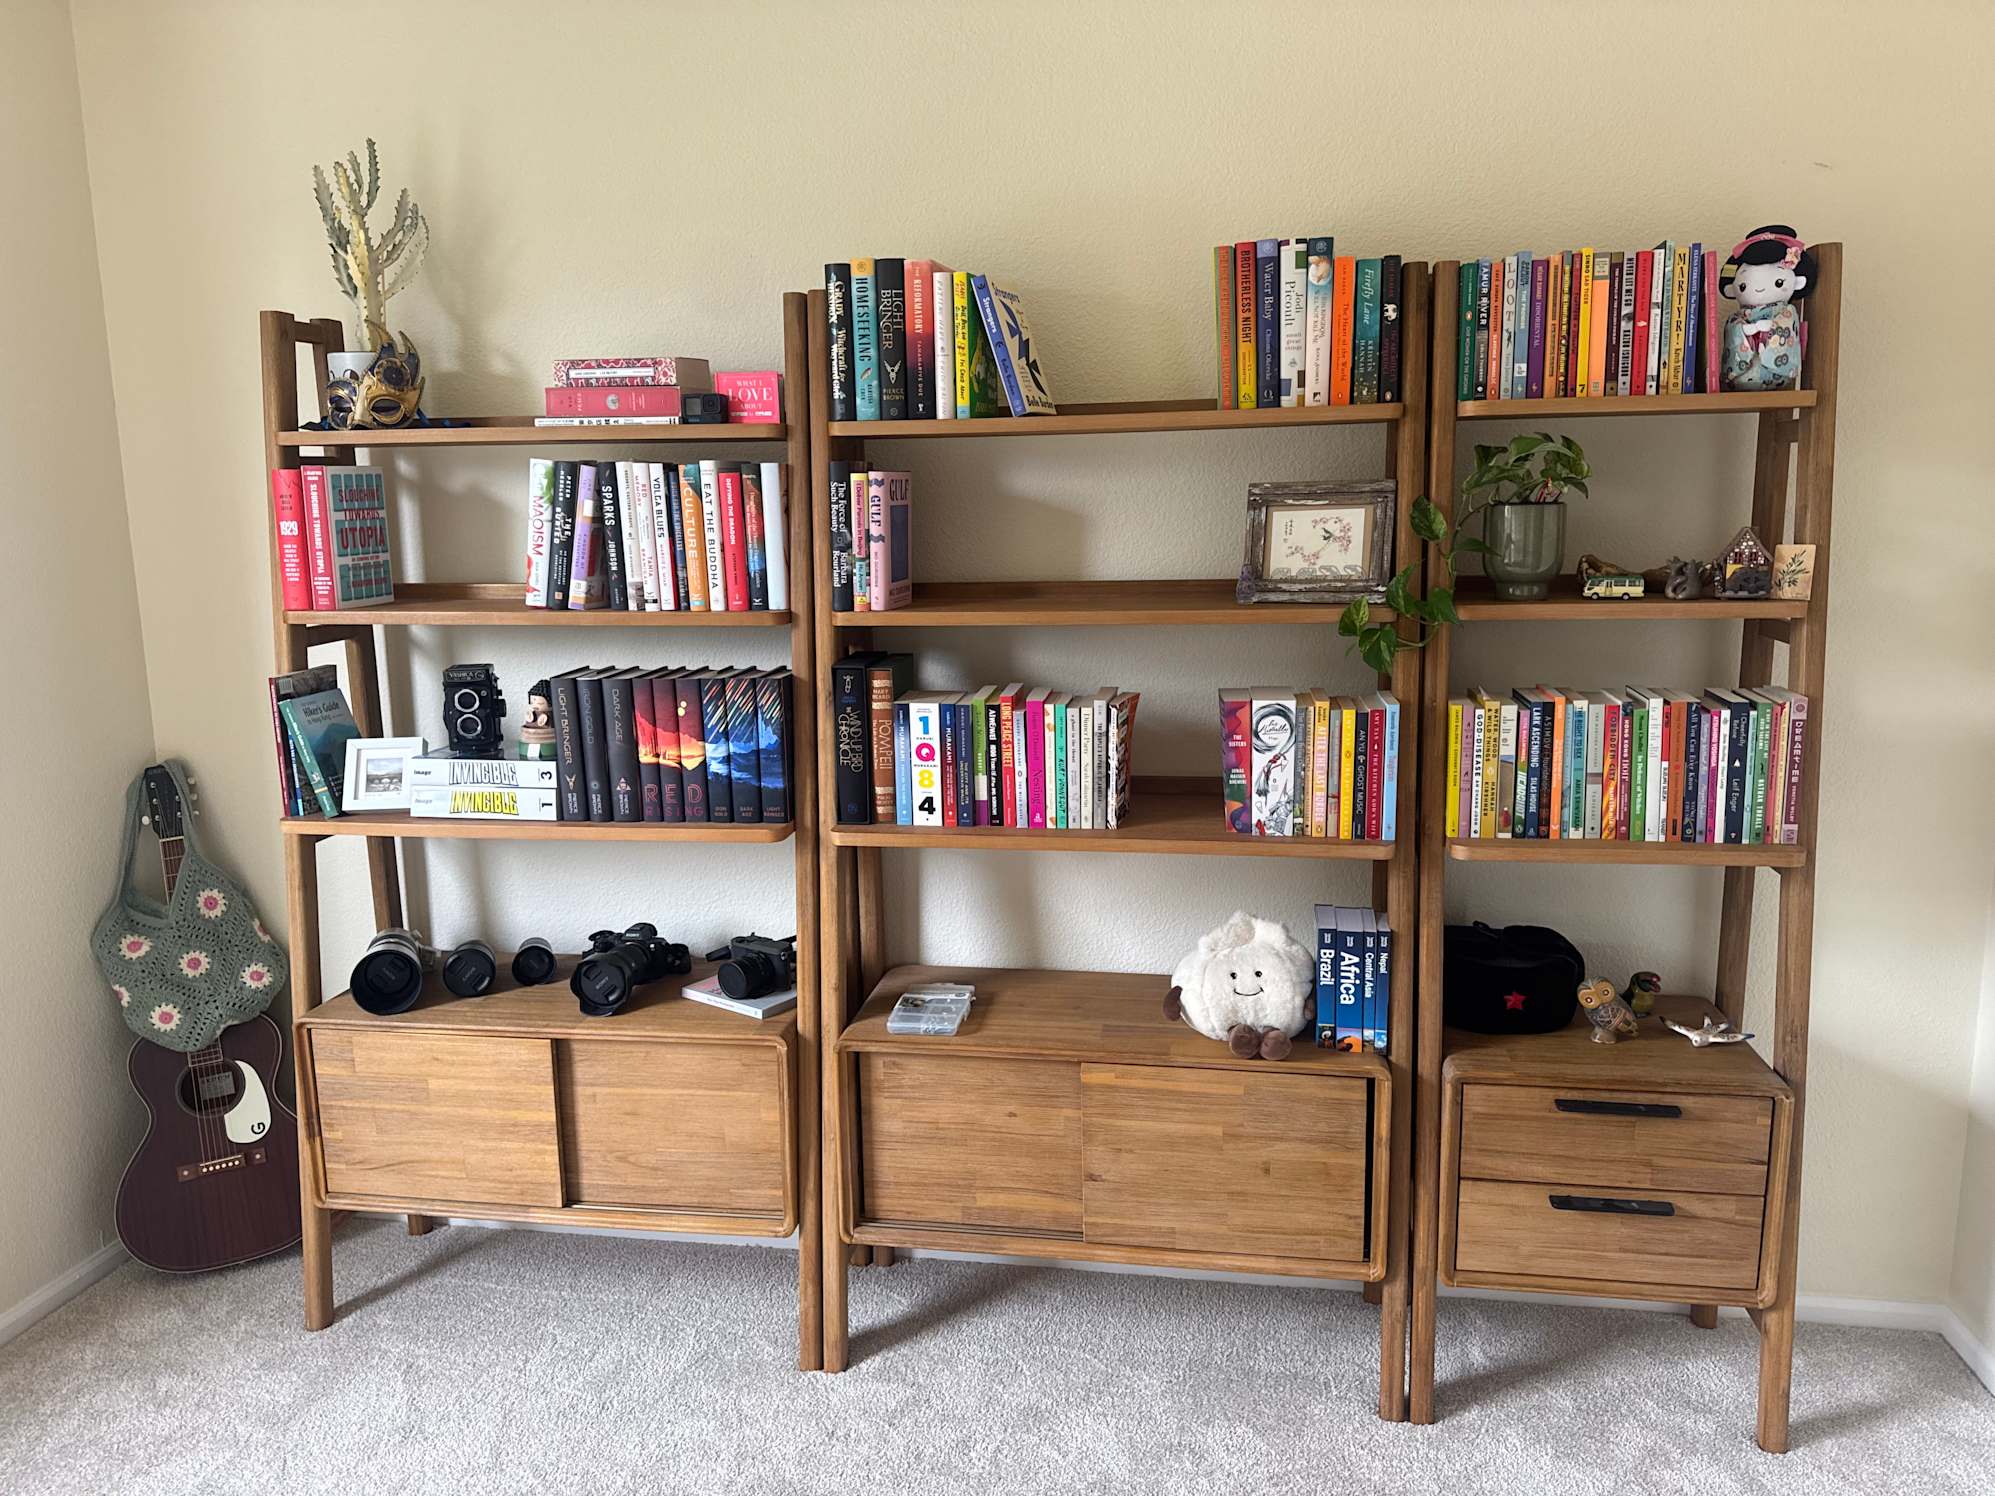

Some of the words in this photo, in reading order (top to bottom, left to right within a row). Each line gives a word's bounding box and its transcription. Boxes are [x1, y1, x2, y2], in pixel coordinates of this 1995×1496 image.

[1264, 262, 1274, 294] Water
[1626, 258, 1635, 275] NEVER
[1240, 250, 1252, 314] BROTHERLESS
[1362, 269, 1375, 299] Firefly
[1481, 267, 1489, 294] AMUR
[1626, 277, 1634, 288] LET
[828, 282, 838, 324] HENDRIX
[834, 281, 846, 317] GRADY
[892, 289, 904, 331] LIGHT
[913, 280, 923, 334] REFORMATORY
[1262, 296, 1274, 321] Baby
[1284, 280, 1297, 327] Picoult
[1294, 292, 1304, 314] Jodi
[1479, 296, 1489, 326] RIVER
[1625, 298, 1632, 307] GO
[855, 278, 873, 362] HOMESEEKING
[879, 289, 894, 349] BRINGER
[982, 297, 998, 334] Strangers
[1362, 302, 1373, 325] Lane
[1241, 316, 1252, 344] NIGHT
[1623, 329, 1631, 348] KAZUO
[831, 343, 841, 379] Wayward
[838, 329, 848, 372] Witchcraft
[1359, 341, 1367, 373] HANNAH
[1366, 340, 1374, 372] KRISTIN
[1621, 349, 1630, 377] ISHIGURO
[728, 388, 772, 401] LOVE
[833, 379, 841, 399] Girls
[310, 483, 320, 518] SLOUCHING
[338, 487, 380, 503] SLOUCHING
[652, 477, 661, 508] VOLGA
[703, 483, 713, 505] EAT
[830, 481, 839, 502] Such
[837, 482, 847, 498] The
[889, 478, 909, 502] GULF
[344, 508, 380, 521] TOWARDS
[601, 485, 615, 527] SPARKS
[830, 503, 841, 533] Beauty
[838, 500, 848, 522] Force
[870, 495, 882, 528] GULF
[279, 520, 299, 536] 1929
[313, 519, 323, 550] TOWARDS
[531, 496, 544, 556] MAOISM
[553, 506, 563, 544] BURIED
[564, 517, 572, 537] THE
[656, 509, 665, 539] BLUES
[683, 487, 698, 560] CULTURE
[706, 510, 714, 534] THE
[729, 517, 737, 545] DRAGON
[339, 525, 385, 549] UTOPIA
[316, 551, 325, 574] UTOPIA
[608, 540, 618, 571] JOHNSON
[708, 538, 719, 590] BUDDHA
[839, 551, 849, 584] Barbara
[832, 550, 842, 588] Bourland
[322, 701, 341, 713] Guide
[558, 687, 569, 717] LIGHT
[582, 689, 592, 714] IRON
[611, 688, 622, 718] DARK
[1001, 702, 1014, 721] LONG
[1532, 707, 1542, 727] LARK
[1690, 711, 1701, 722] All
[561, 719, 572, 765] BRINGER
[585, 715, 594, 744] GOLD
[614, 720, 623, 745] AGE
[838, 713, 852, 767] CHRONICLE
[1002, 721, 1014, 743] PEACE
[1359, 729, 1366, 740] AN
[1543, 715, 1551, 749] ASIMOV
[1609, 711, 1619, 759] FORBIDDEN
[1689, 724, 1700, 738] You
[1732, 719, 1740, 740] Refuse
[1738, 717, 1747, 747] Cheerfully
[878, 719, 893, 770] POMPEII
[1002, 743, 1014, 768] STREET
[1474, 713, 1484, 778] GOD-DISEASE
[1530, 727, 1541, 768] ASCENDING
[1690, 739, 1698, 753] Can
[1710, 744, 1718, 767] YOSHIDA
[449, 762, 520, 787] INVINCIBLE
[1058, 759, 1066, 776] KURT
[1688, 754, 1700, 770] Ever
[540, 771, 553, 780] 3
[1357, 765, 1365, 790] GHOST
[1530, 777, 1538, 793] SILAS
[1687, 771, 1698, 791] Know
[1731, 778, 1740, 791] Leif
[449, 789, 520, 816] INVINCIBLE
[644, 783, 704, 804] RED
[1058, 778, 1066, 813] VONNEGUT
[1356, 791, 1364, 815] MUSIC
[1516, 771, 1528, 819] HEADSHOT
[1529, 794, 1537, 813] HOUSE
[1728, 792, 1739, 813] Enger
[1756, 779, 1765, 803] NATHAN
[645, 805, 704, 817] RISING
[1755, 805, 1763, 829] THRALL
[1319, 948, 1335, 986] Brazil
[1364, 952, 1375, 981] Central
[1378, 952, 1389, 974] Nepal
[1339, 951, 1361, 1006] Africa
[1364, 981, 1374, 999] Asia
[250, 1122, 266, 1135] G
